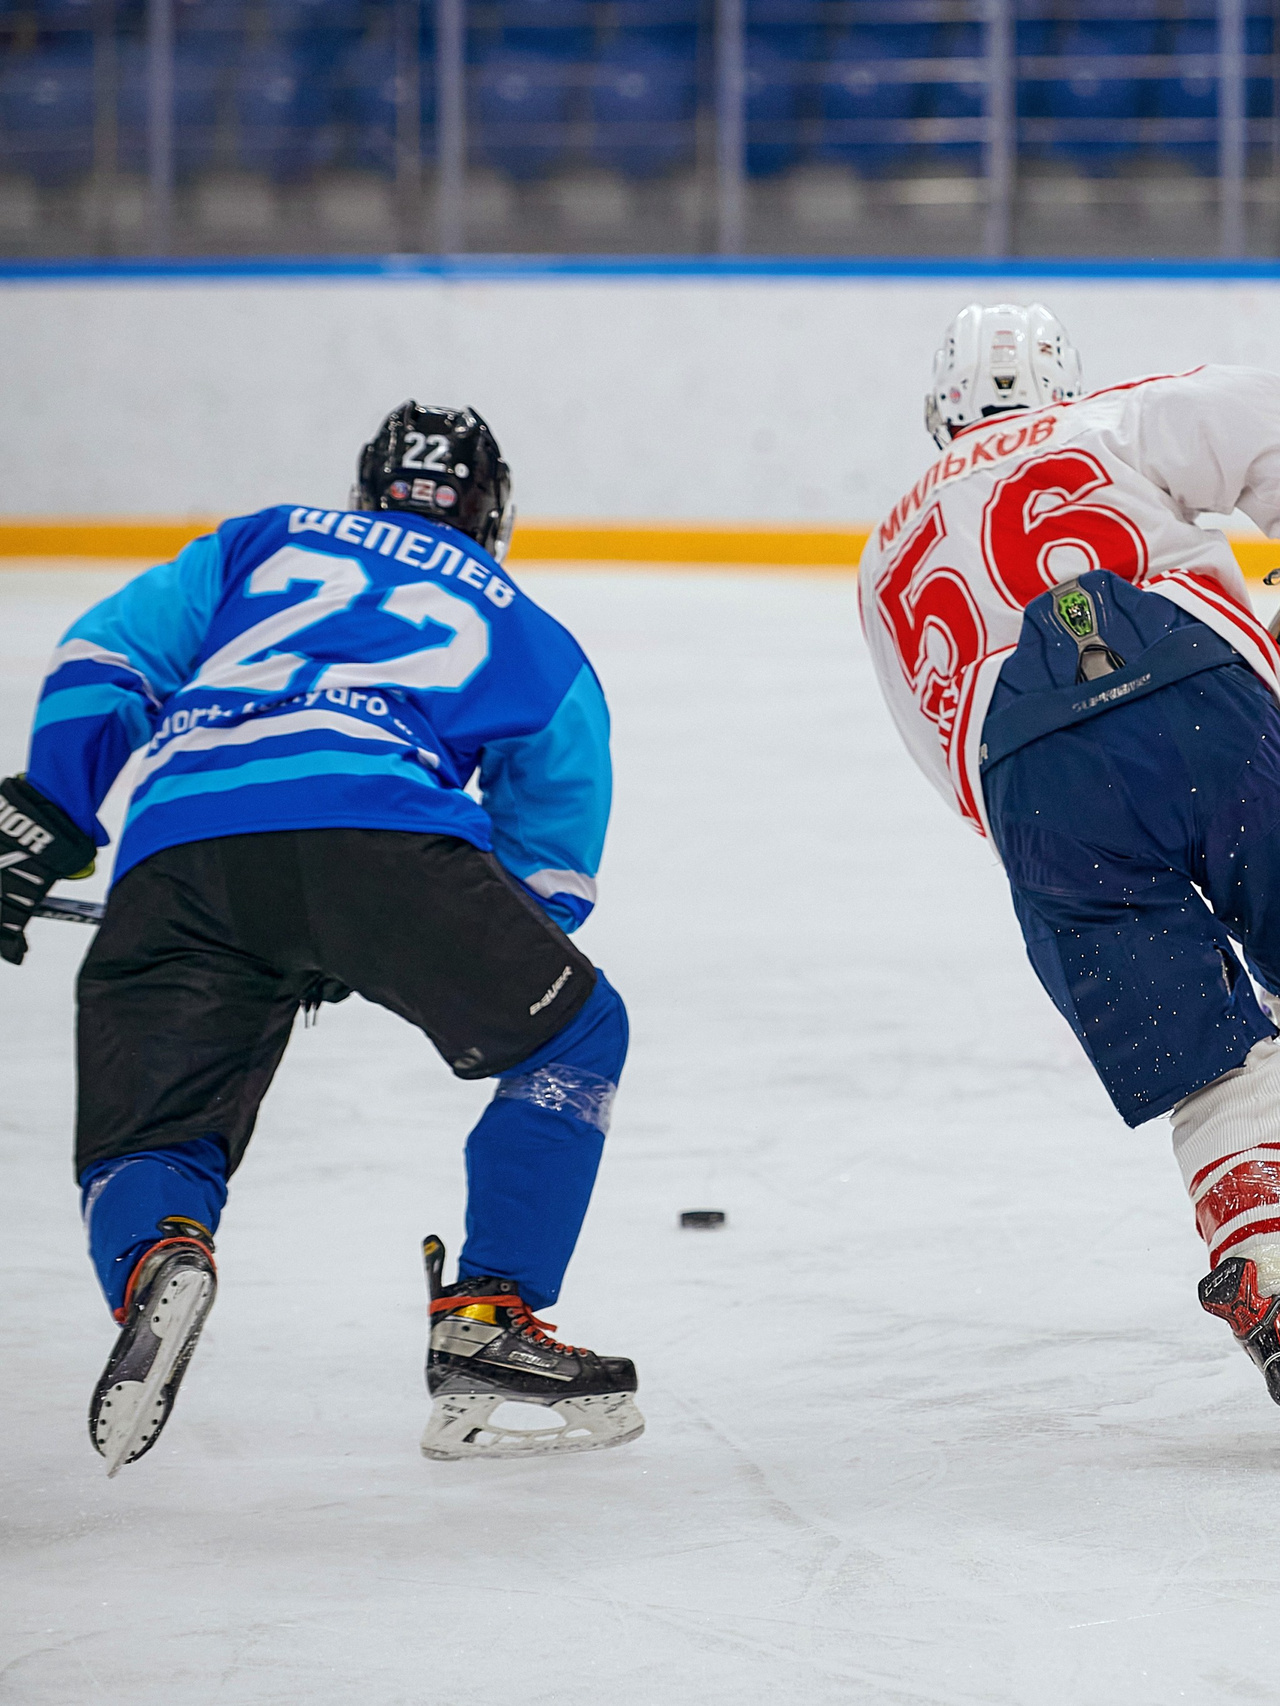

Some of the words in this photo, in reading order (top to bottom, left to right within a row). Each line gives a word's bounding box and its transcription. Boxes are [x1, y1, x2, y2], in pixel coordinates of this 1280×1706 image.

[402, 431, 449, 472] 22
[878, 414, 1058, 553] МИЛЬКОВ
[287, 506, 517, 609] ШЕПЕЛЕВ
[874, 447, 1148, 695] 56
[175, 543, 491, 694] 22
[0, 795, 55, 855] IOR
[1205, 1263, 1238, 1297] CCM
